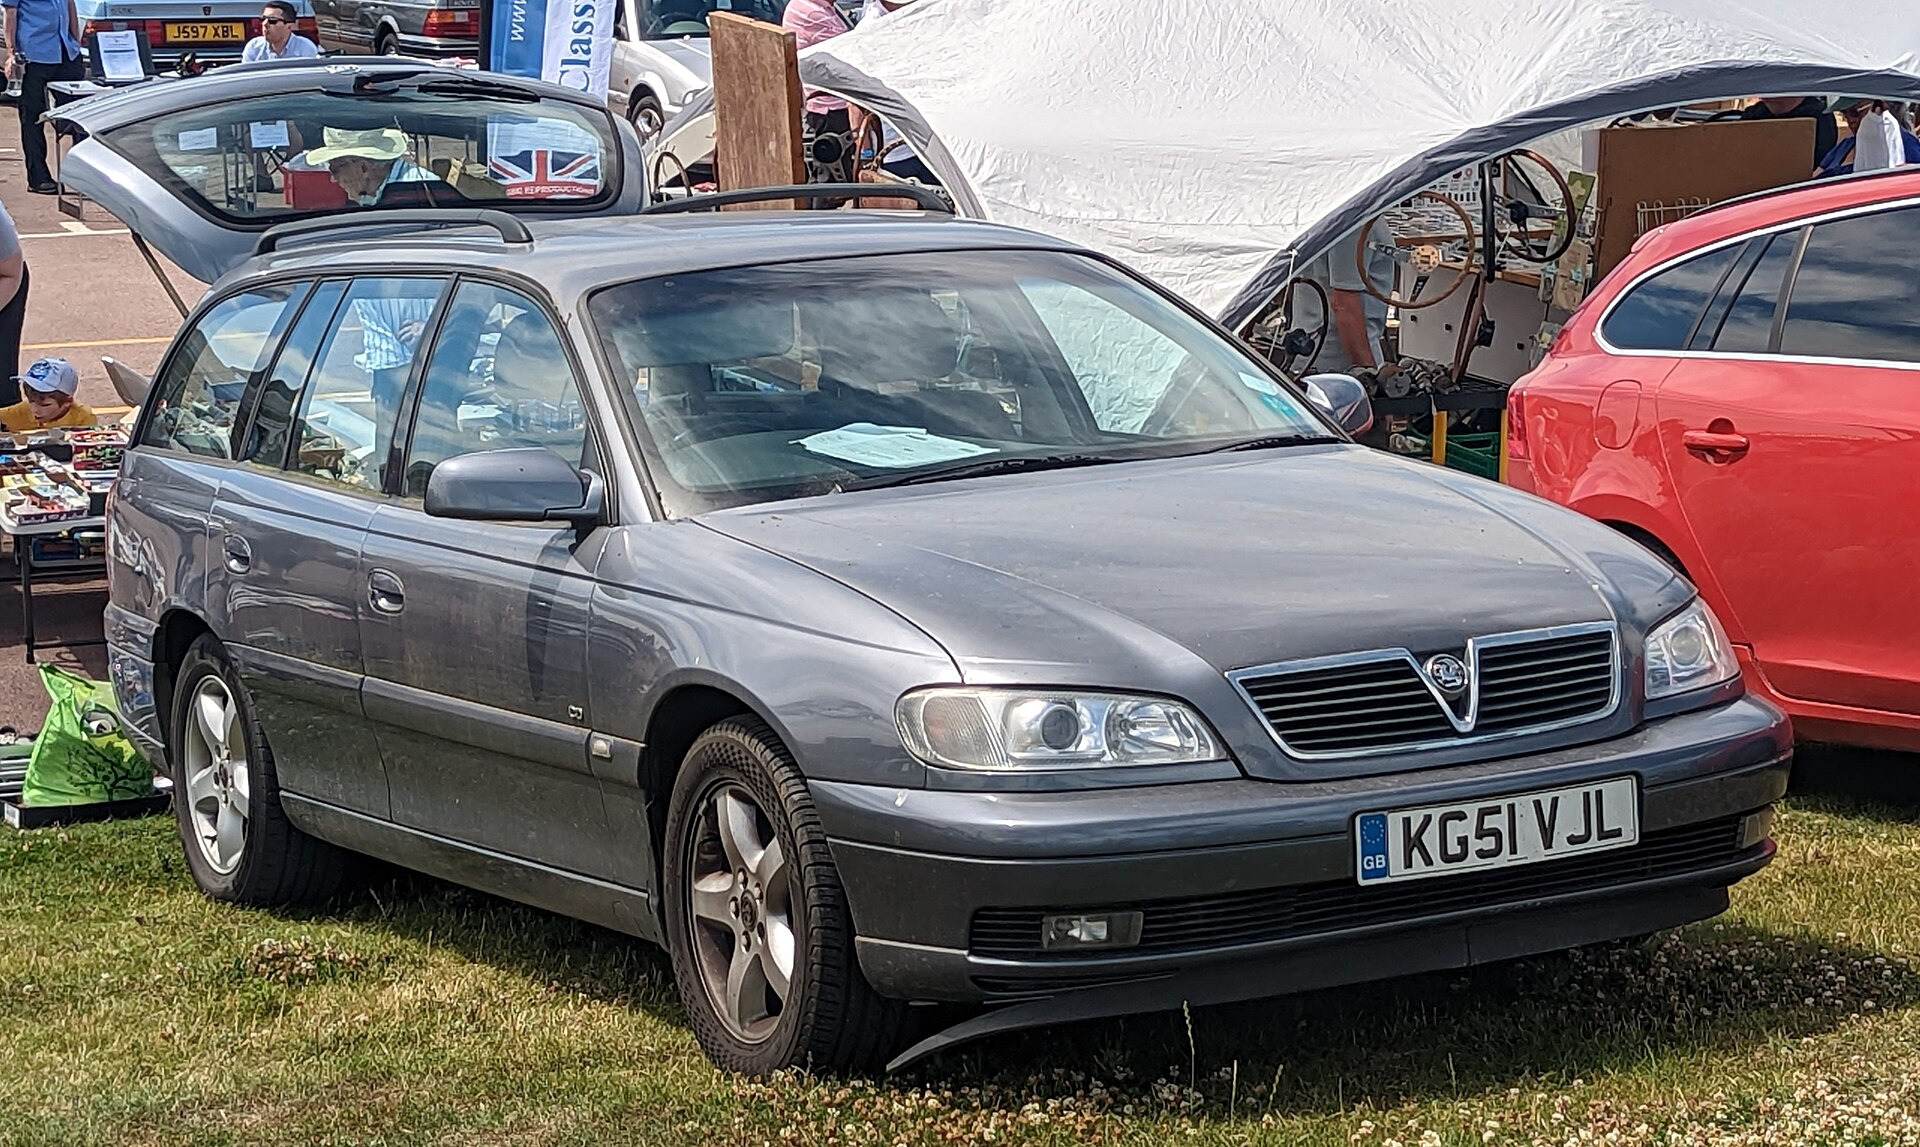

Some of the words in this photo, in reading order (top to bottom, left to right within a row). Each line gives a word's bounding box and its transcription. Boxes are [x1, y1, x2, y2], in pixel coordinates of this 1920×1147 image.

[173, 25, 207, 39] J597
[212, 25, 239, 39] XBL
[510, 0, 528, 41] ww
[559, 0, 596, 92] Class
[1402, 802, 1519, 870] KG51
[1533, 788, 1623, 851] VJL
[1363, 854, 1386, 869] GB
